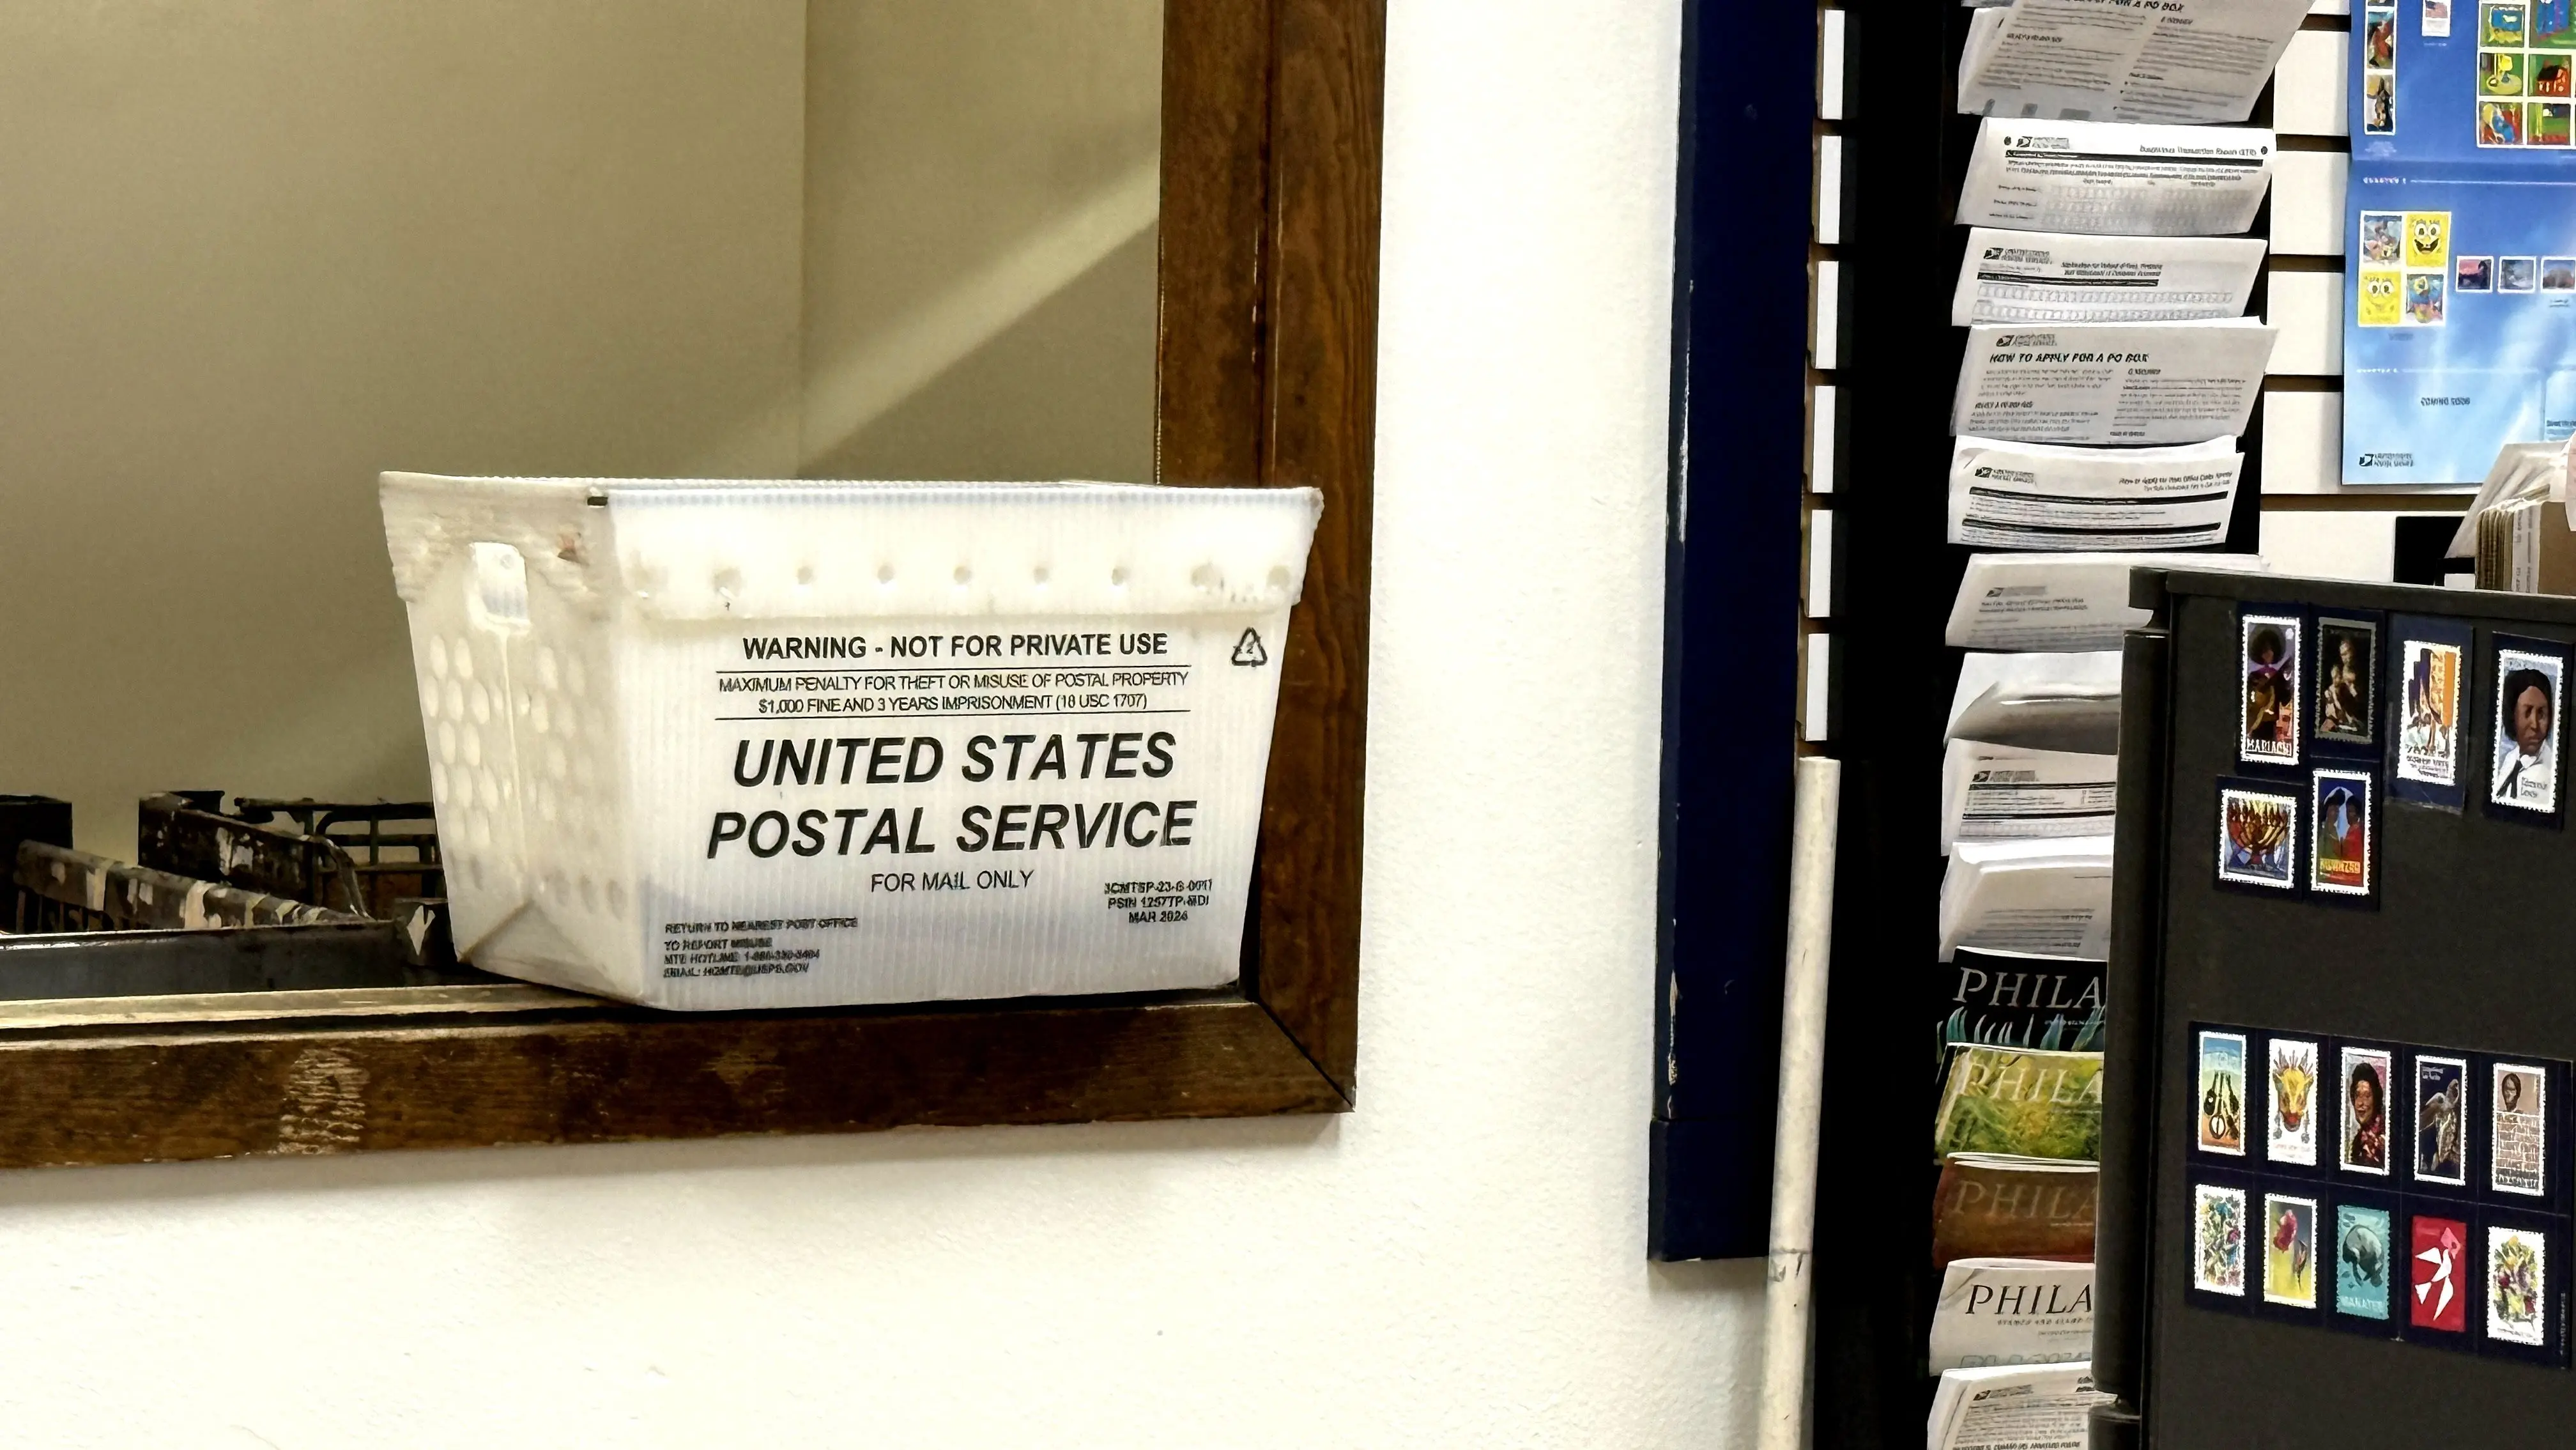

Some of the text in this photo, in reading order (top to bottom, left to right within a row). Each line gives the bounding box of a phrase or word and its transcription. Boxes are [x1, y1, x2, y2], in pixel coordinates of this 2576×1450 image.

[1989, 353, 2015, 363] HOW
[2019, 353, 2032, 362] TO
[2035, 353, 2069, 363] APPLY
[2072, 353, 2093, 363] FOR
[2096, 353, 2104, 362] A
[2107, 353, 2122, 363] PO
[743, 635, 866, 659] WARNING
[891, 635, 943, 659] NOT
[951, 634, 1002, 657] FOR
[1010, 633, 1112, 656] PRIVATE
[1119, 632, 1168, 655] USE
[719, 671, 1189, 693] MAXIMUM PENALTY FOR THEFT OR MISUSE OF POSTAL PROPERTY
[758, 693, 1148, 714] $1,000 FINE AND 3 YEARS IMPRISONMENT (18 USC 1707)
[732, 730, 1176, 787] UNITED STATES
[707, 800, 1198, 859] POSTAL SERVICE
[871, 869, 1034, 892] FOR MAIL ONLY
[664, 922, 712, 934] RETURN
[714, 921, 730, 932] TO
[1128, 911, 1156, 923] MAR
[663, 940, 680, 952] TO
